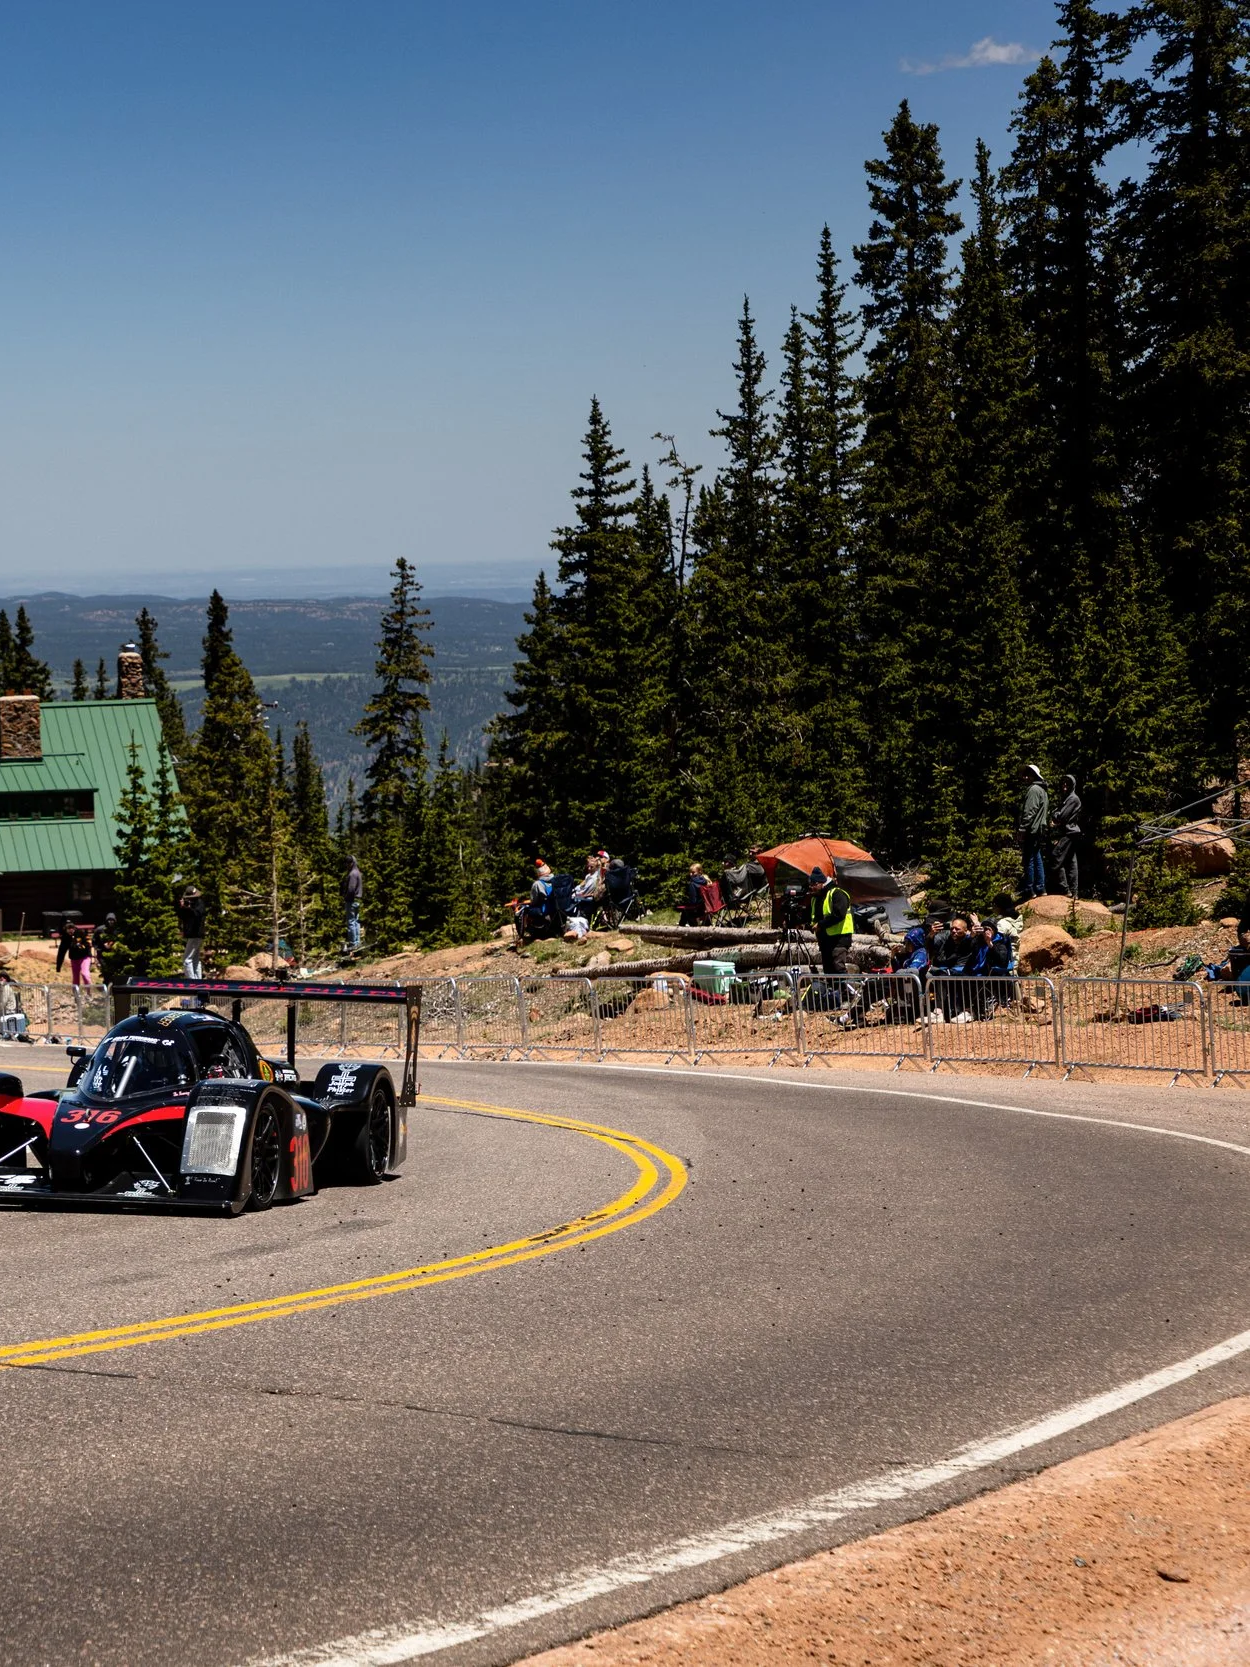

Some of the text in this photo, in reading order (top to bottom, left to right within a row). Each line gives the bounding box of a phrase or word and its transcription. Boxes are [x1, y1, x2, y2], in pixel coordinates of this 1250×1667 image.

[136, 981, 406, 998] HONOR THE FALLEN
[60, 1109, 122, 1124] 316
[290, 1133, 309, 1192] 316
